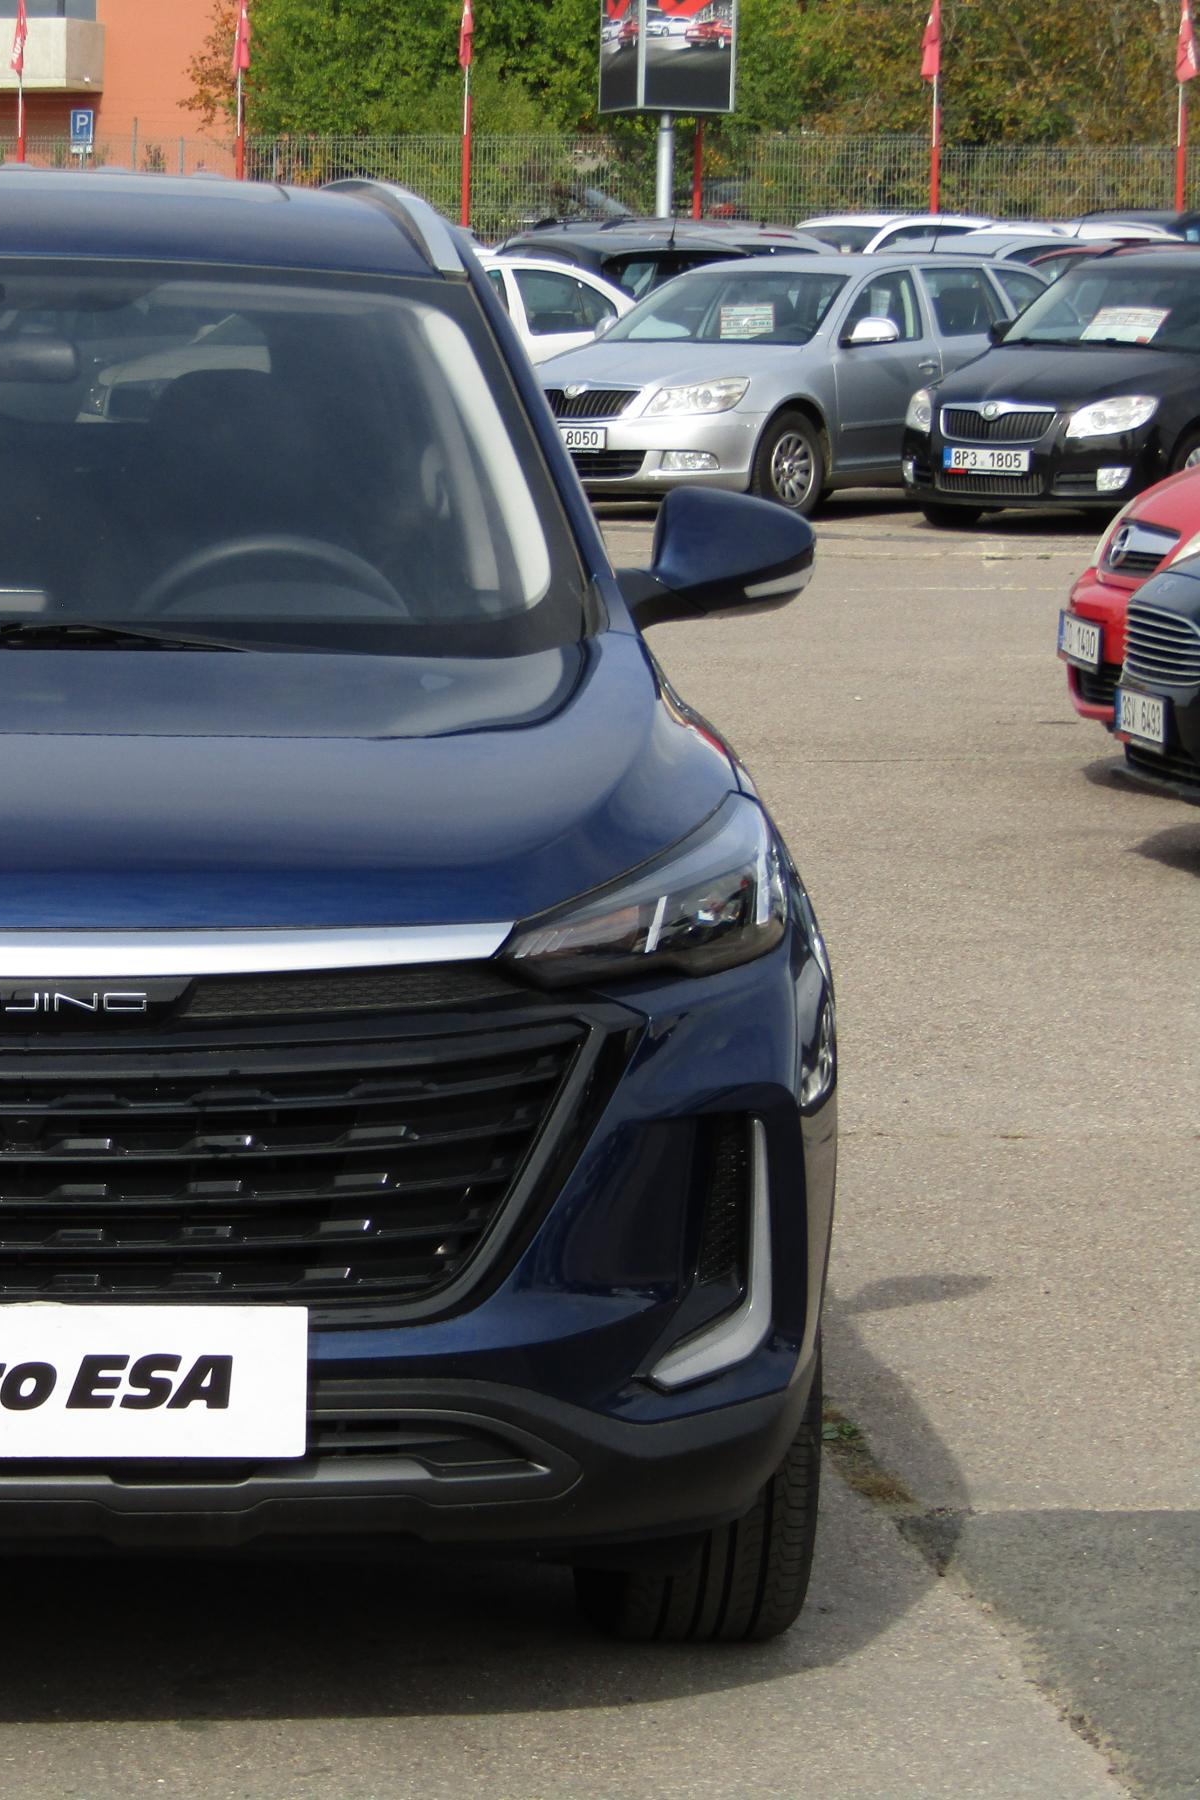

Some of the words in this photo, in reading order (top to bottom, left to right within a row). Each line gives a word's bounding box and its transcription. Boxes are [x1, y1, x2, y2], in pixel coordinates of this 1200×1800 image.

[76, 114, 89, 133] P
[566, 431, 598, 445] 8050
[954, 451, 977, 467] 8P3
[989, 453, 1021, 469] 1805
[65, 1353, 233, 1410] ESA
